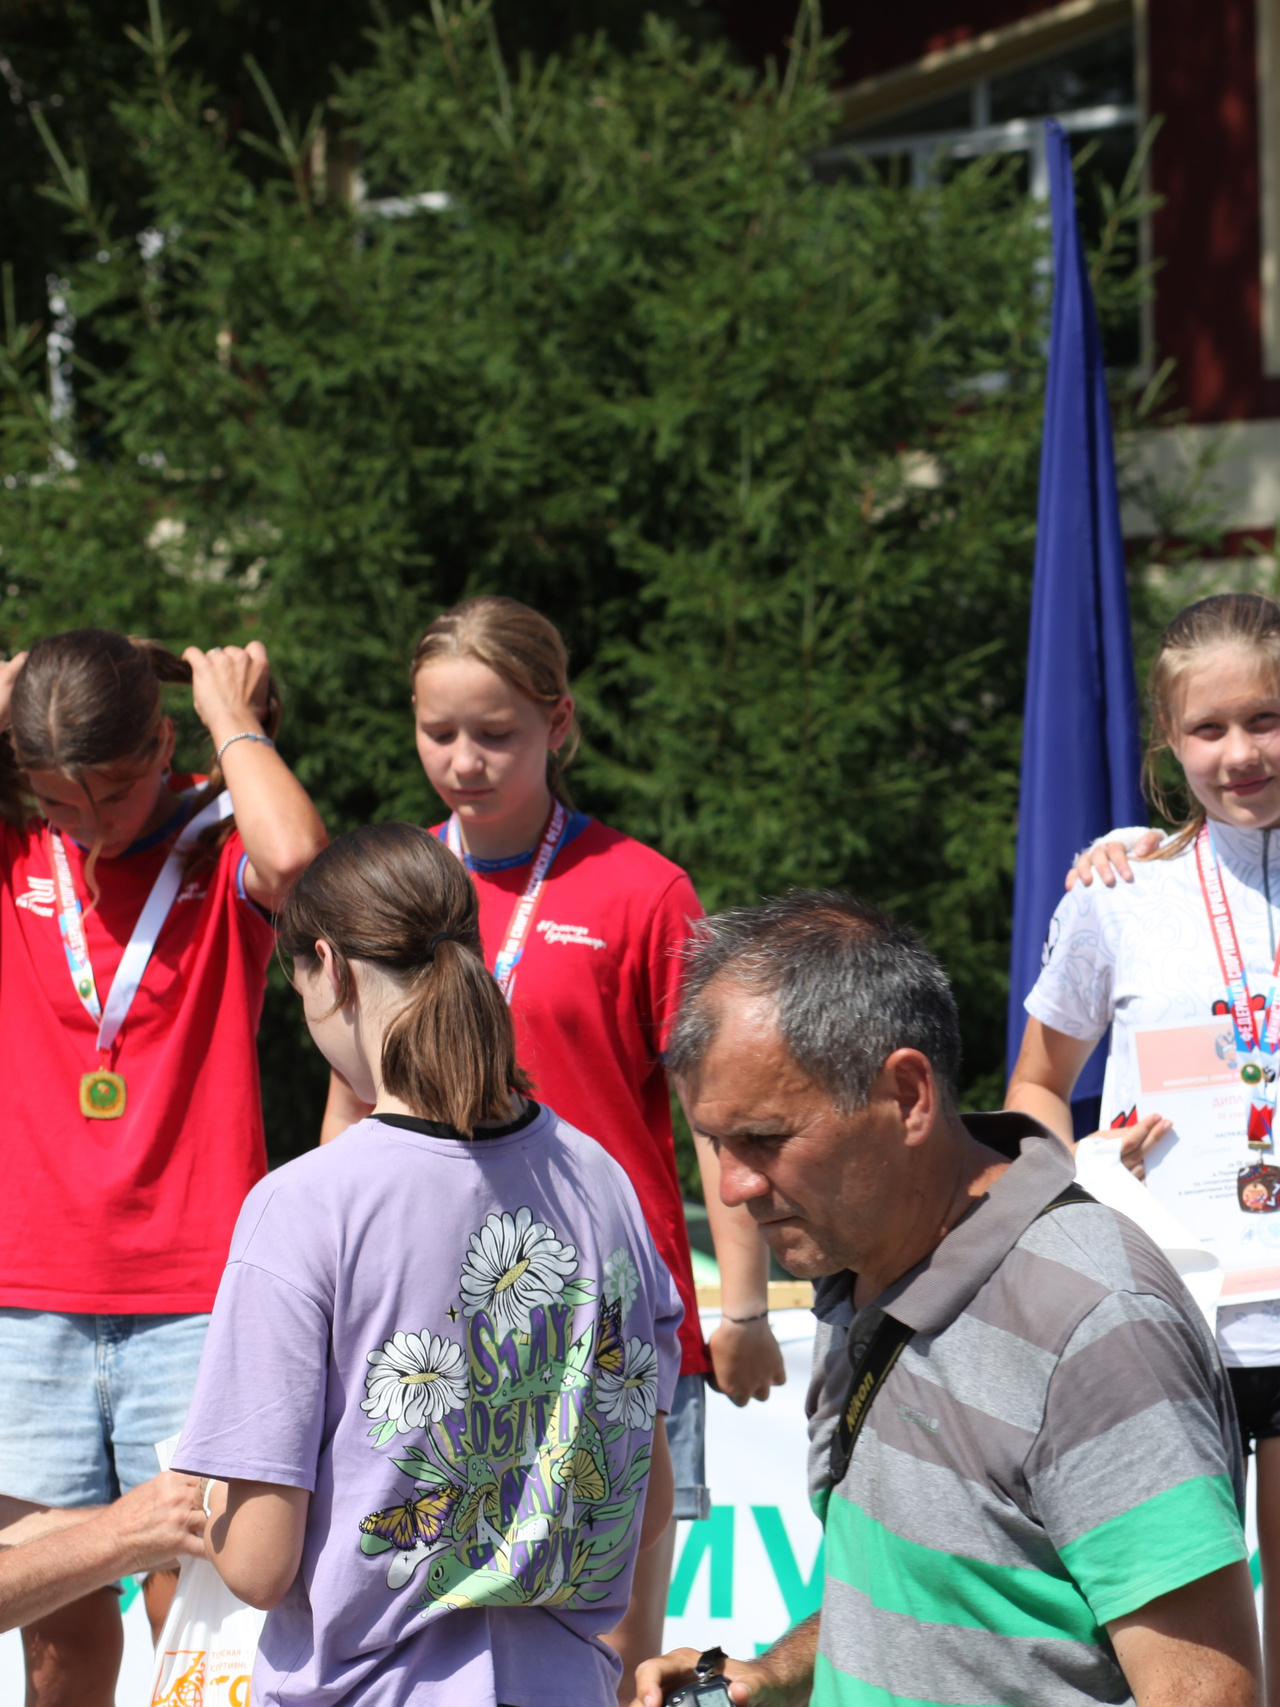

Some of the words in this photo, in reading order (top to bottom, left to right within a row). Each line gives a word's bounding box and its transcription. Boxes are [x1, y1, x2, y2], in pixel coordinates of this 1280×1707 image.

[1212, 1094, 1244, 1108] ДИПЛ
[471, 1303, 572, 1396] STAY
[845, 1371, 874, 1433] Nikon
